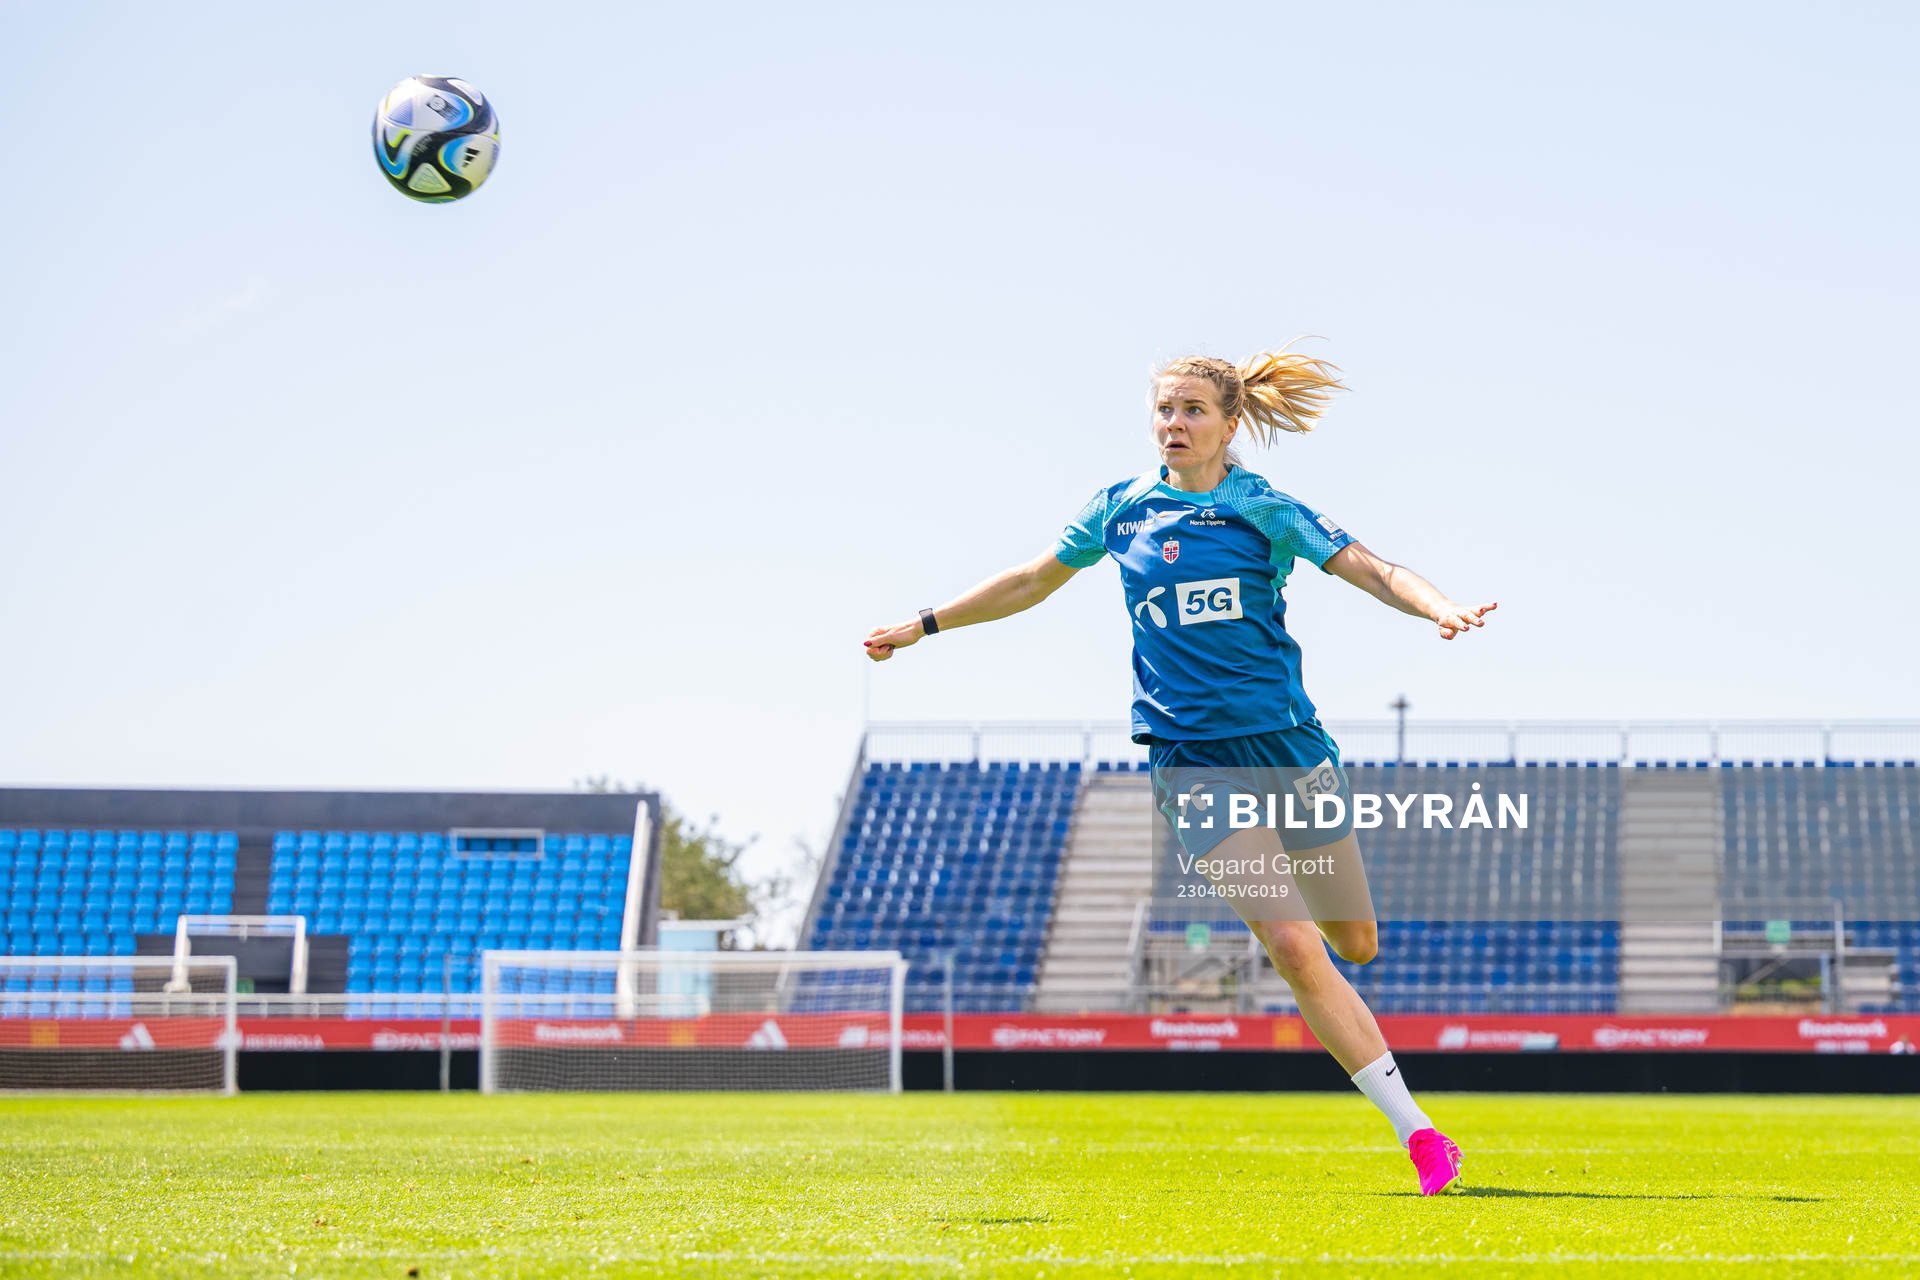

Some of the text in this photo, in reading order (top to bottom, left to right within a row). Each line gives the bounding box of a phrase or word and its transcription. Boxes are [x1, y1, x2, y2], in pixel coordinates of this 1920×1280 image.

[1117, 520, 1145, 536] KIWI
[1206, 519, 1226, 527] Tipping
[1185, 587, 1234, 616] 5G
[1305, 768, 1335, 801] 5G
